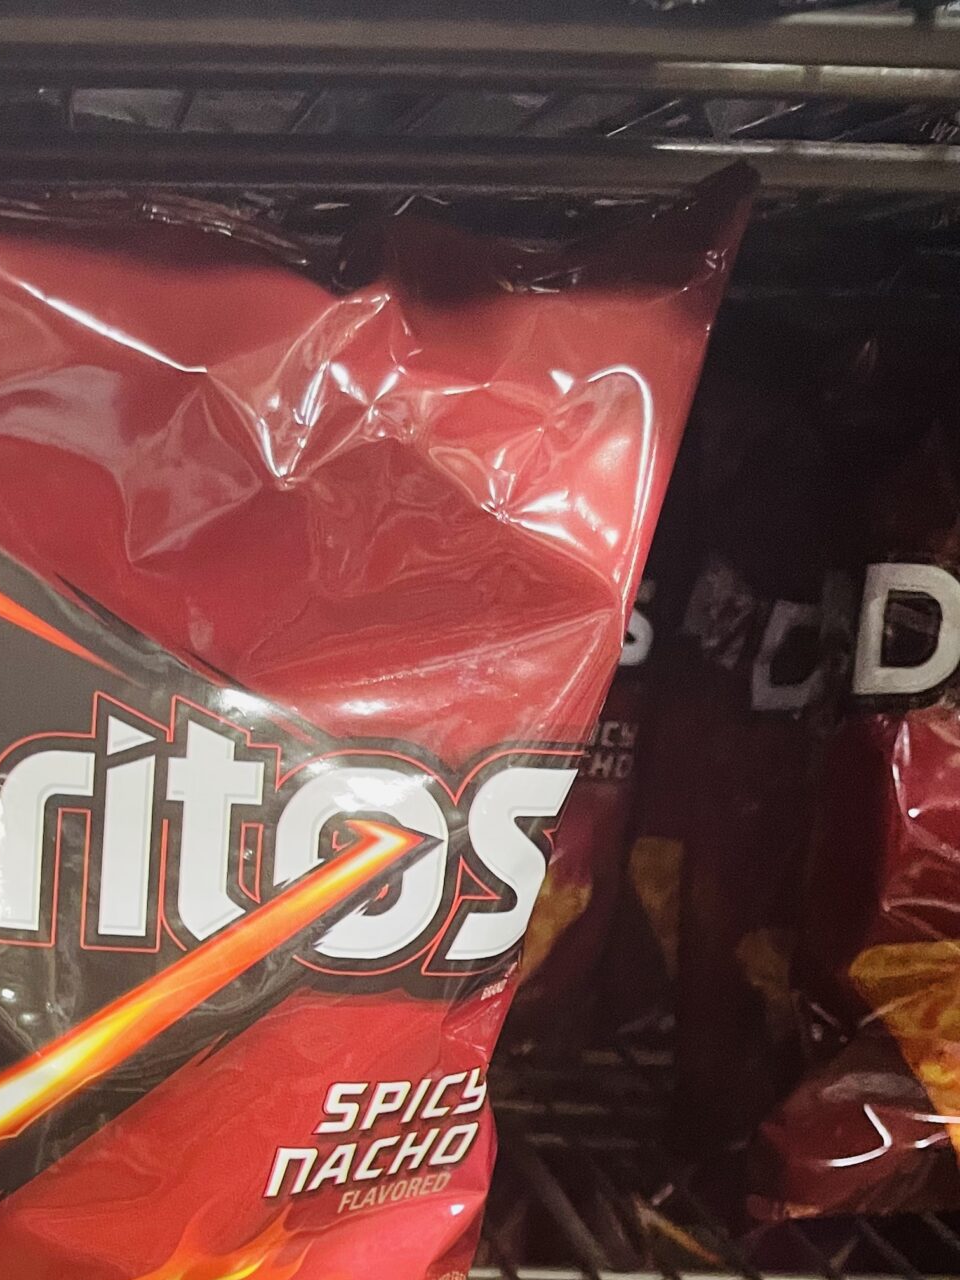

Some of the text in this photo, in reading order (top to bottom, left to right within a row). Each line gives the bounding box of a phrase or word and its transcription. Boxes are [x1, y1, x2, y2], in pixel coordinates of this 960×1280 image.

[313, 1067, 487, 1134] SPICY
[263, 1122, 479, 1197] NACHO
[337, 1173, 451, 1213] FLAVORED
